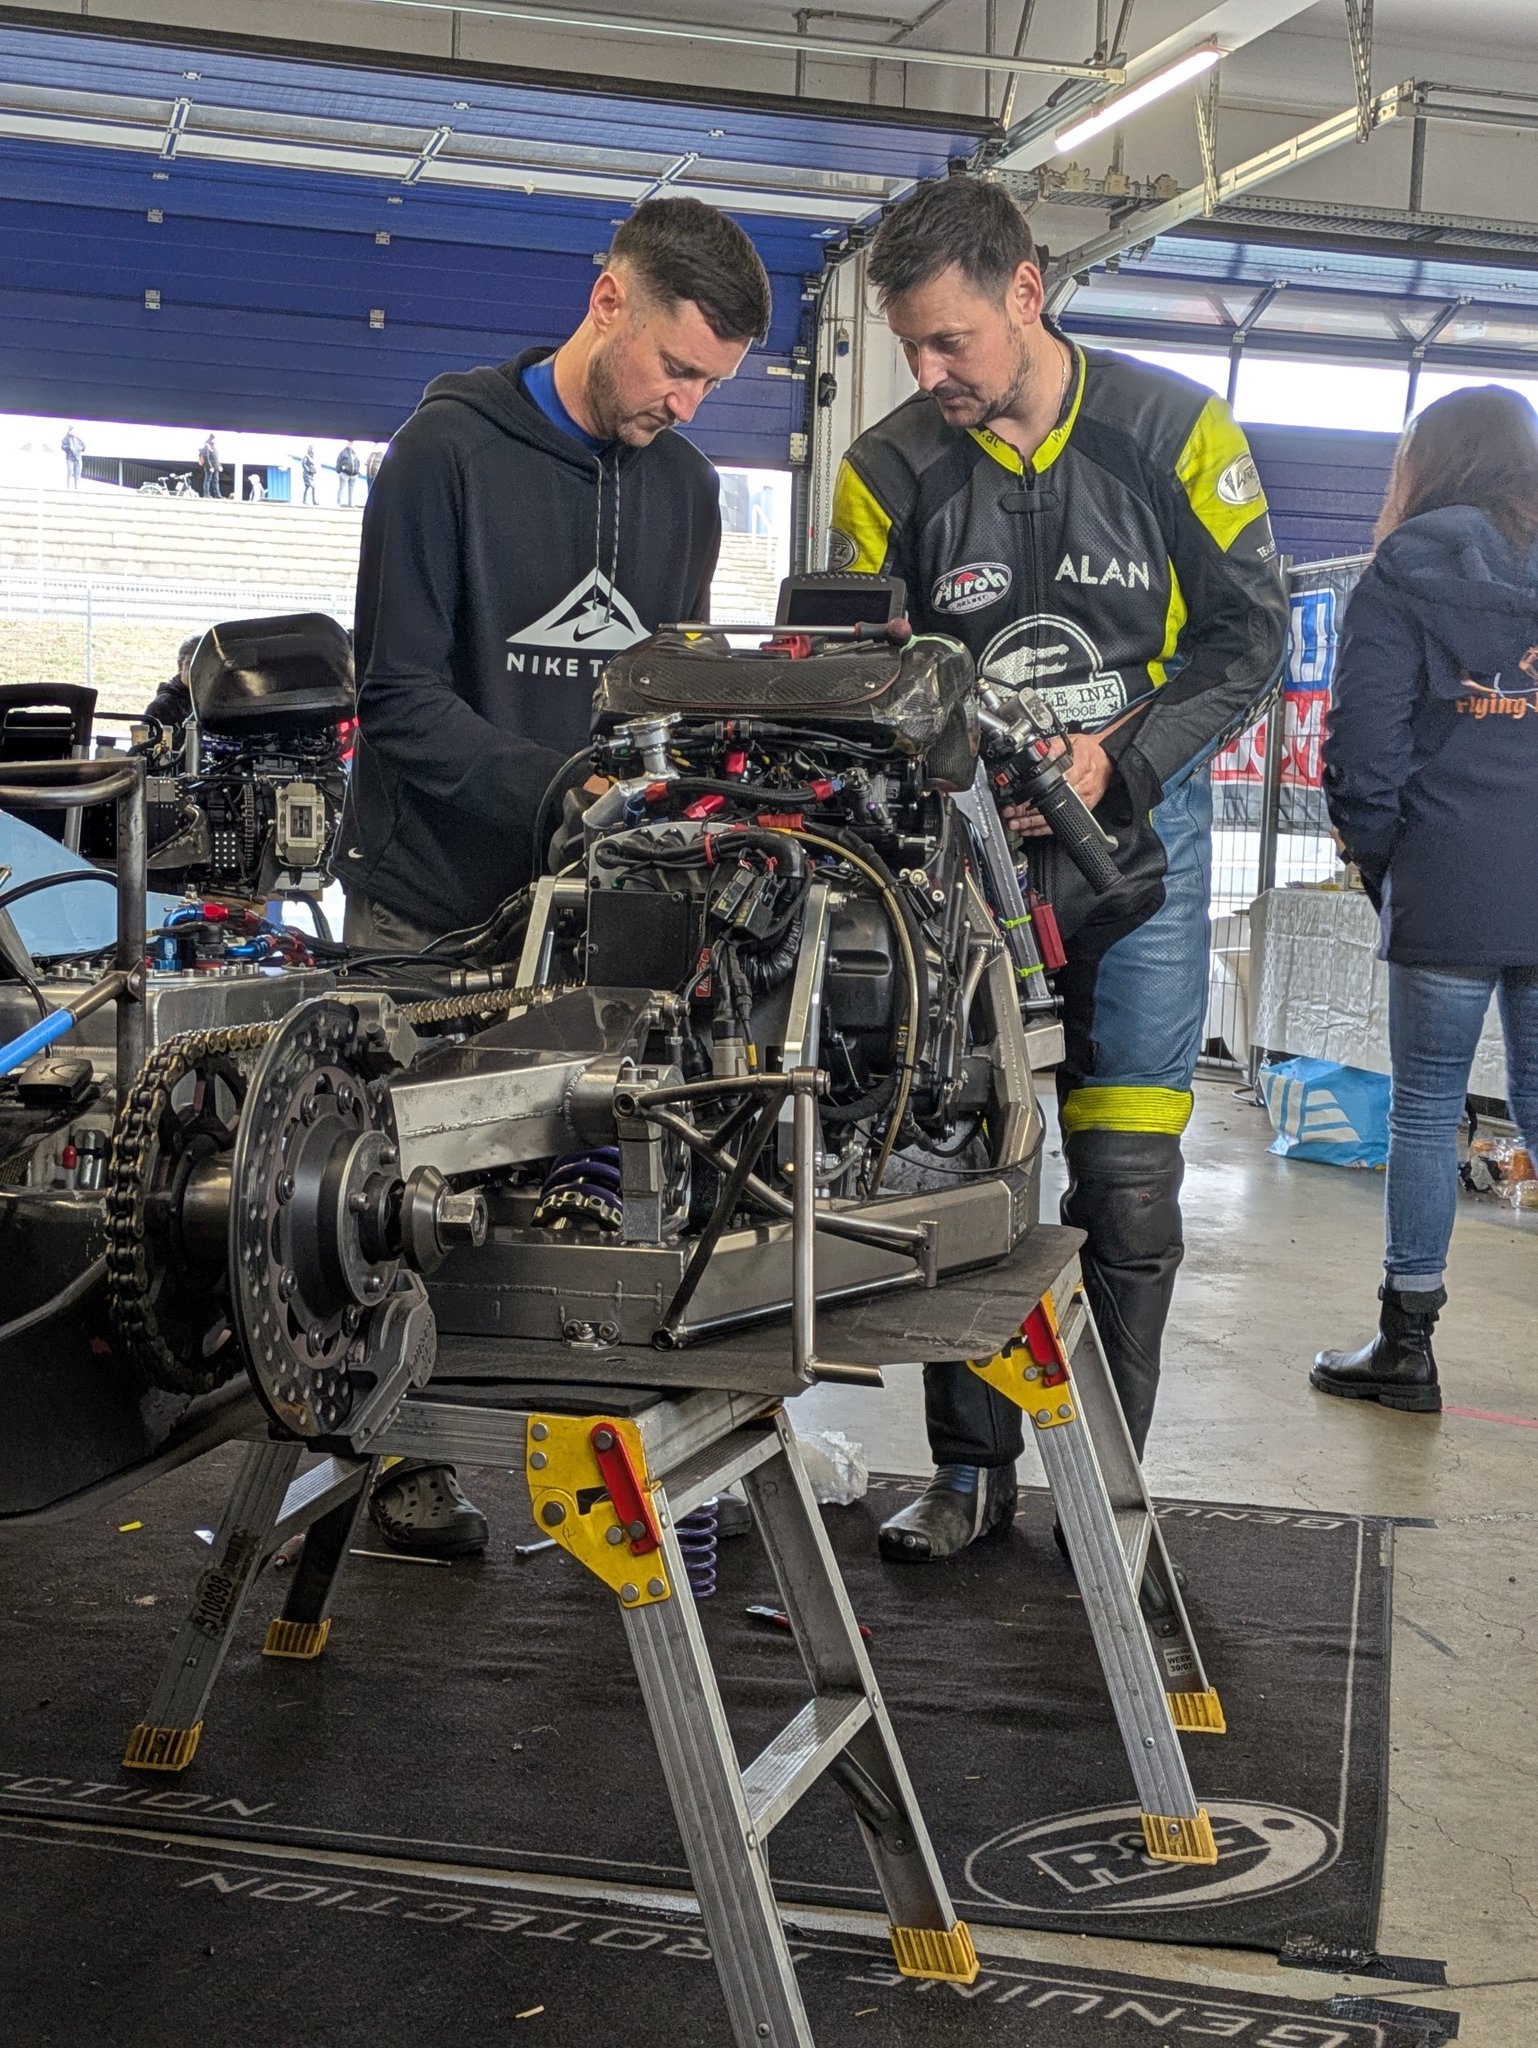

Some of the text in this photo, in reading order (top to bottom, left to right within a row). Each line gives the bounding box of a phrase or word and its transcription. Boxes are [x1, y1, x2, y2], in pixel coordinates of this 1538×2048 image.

[1055, 553, 1149, 591] ALAN
[506, 652, 611, 678] NIKE T
[1077, 683, 1119, 704] INK
[1167, 1655, 1193, 1665] WEEK
[0, 1771, 277, 1817] CTION
[179, 1871, 811, 1963] ROTECTION
